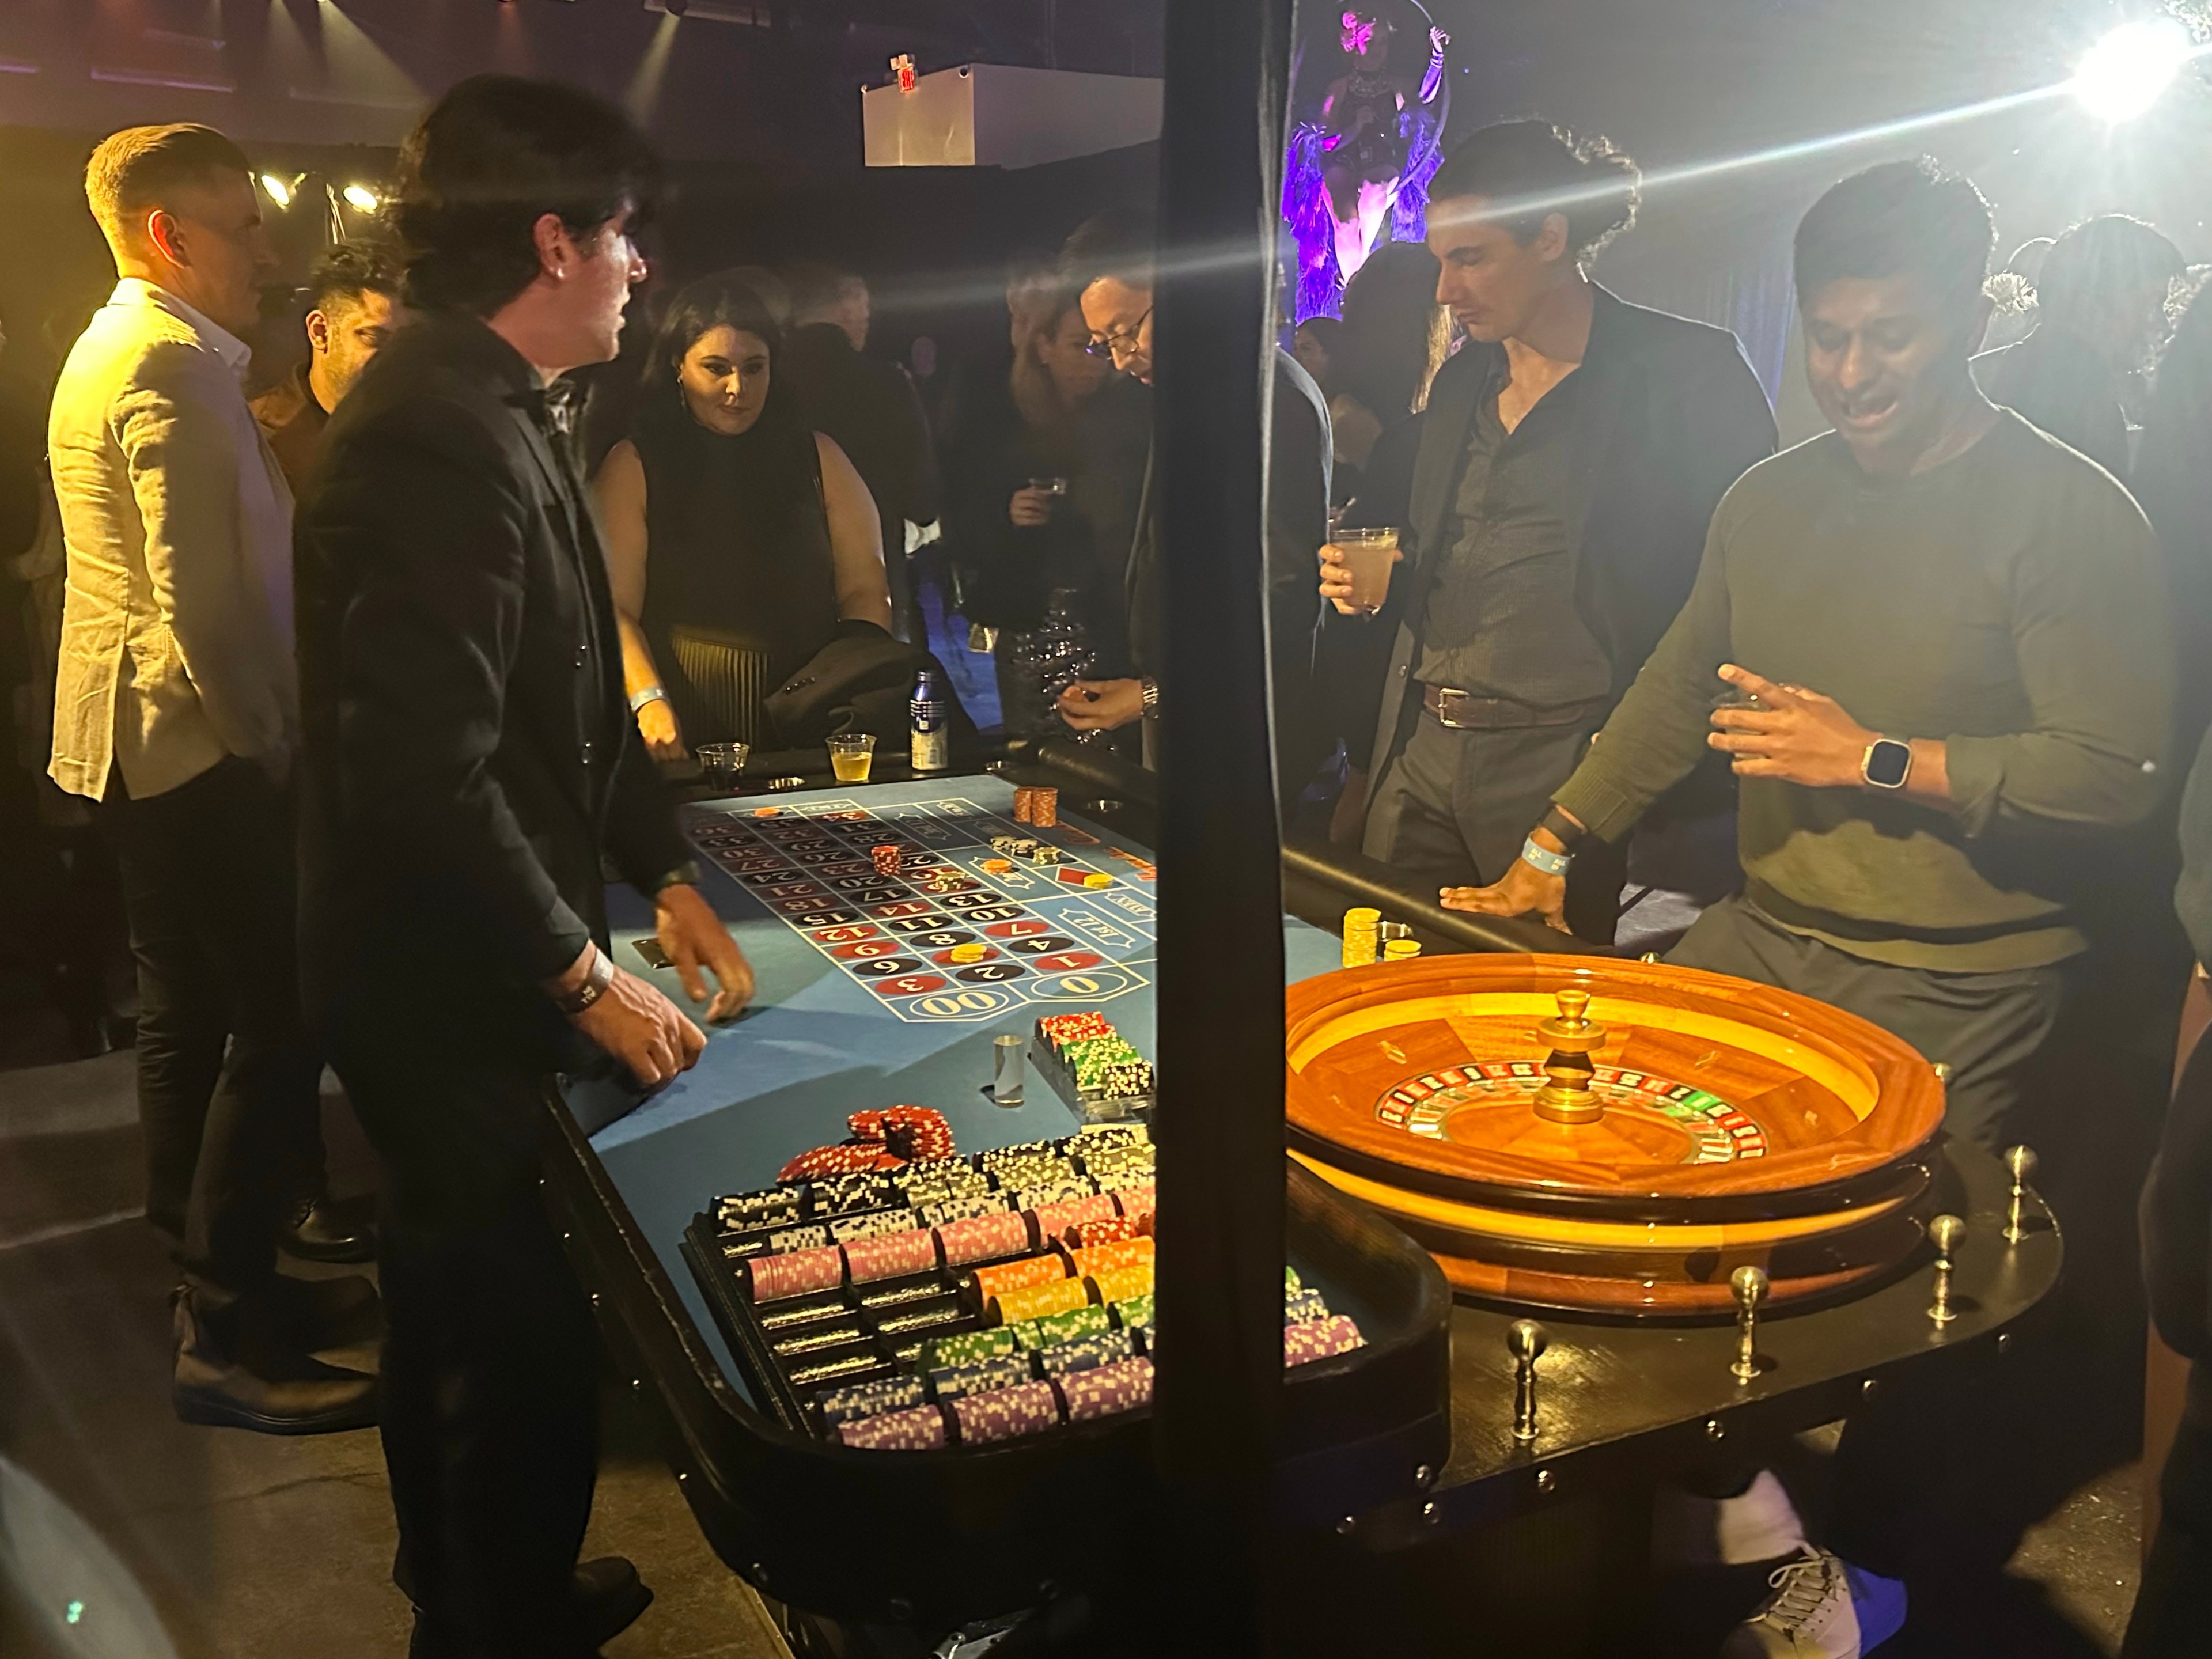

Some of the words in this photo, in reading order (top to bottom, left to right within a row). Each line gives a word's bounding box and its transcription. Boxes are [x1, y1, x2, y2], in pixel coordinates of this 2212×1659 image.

[823, 812, 860, 822] 34
[840, 823, 876, 832] 31
[708, 836, 748, 846] 33
[854, 834, 895, 843] 28
[791, 840, 830, 851] 29
[722, 848, 764, 858] 30
[805, 851, 847, 862] 26
[741, 859, 779, 871] 27
[822, 864, 864, 874] 23
[753, 872, 796, 883] 24
[839, 876, 884, 888] 20
[770, 884, 812, 896] 21
[864, 889, 902, 902] 17
[785, 897, 830, 911] 18
[949, 894, 993, 906] 13
[877, 902, 923, 916] 14
[970, 907, 1016, 921] 10
[803, 912, 849, 925] 15
[895, 917, 944, 930] 11
[819, 927, 869, 940] 12
[1010, 923, 1033, 935] 7
[929, 933, 956, 945] 8
[854, 944, 880, 956] 9
[1028, 940, 1051, 951] 4
[873, 961, 900, 974] 6
[1052, 955, 1081, 968] 1
[974, 967, 1005, 979] 2
[897, 979, 924, 992] 3
[1060, 976, 1099, 993] 0
[922, 991, 997, 1016] 00
